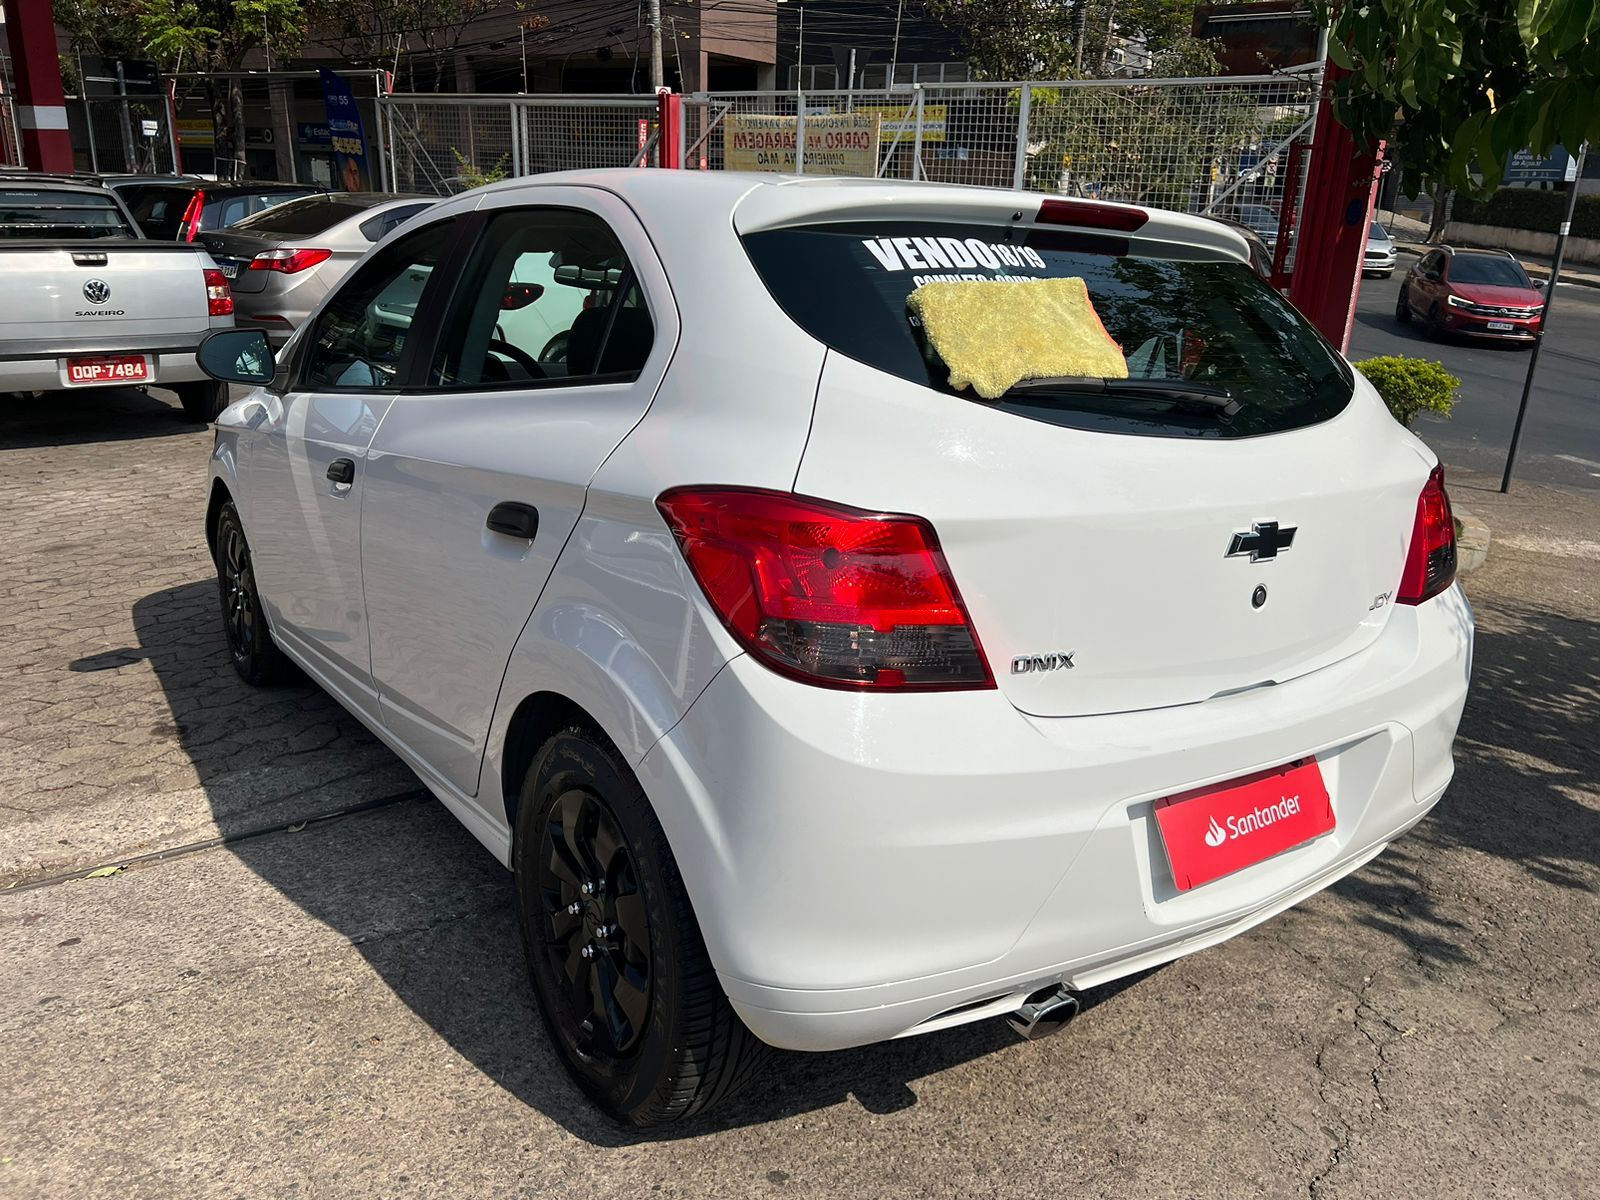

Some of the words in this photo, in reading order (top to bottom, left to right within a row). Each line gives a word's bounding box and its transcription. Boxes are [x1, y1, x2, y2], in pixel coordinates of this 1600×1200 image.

[862, 237, 1001, 271] VENDO
[989, 244, 1047, 269] 18/19
[1368, 590, 1393, 612] JOY
[1010, 651, 1076, 675] ONIX
[1226, 793, 1301, 841] Santander
